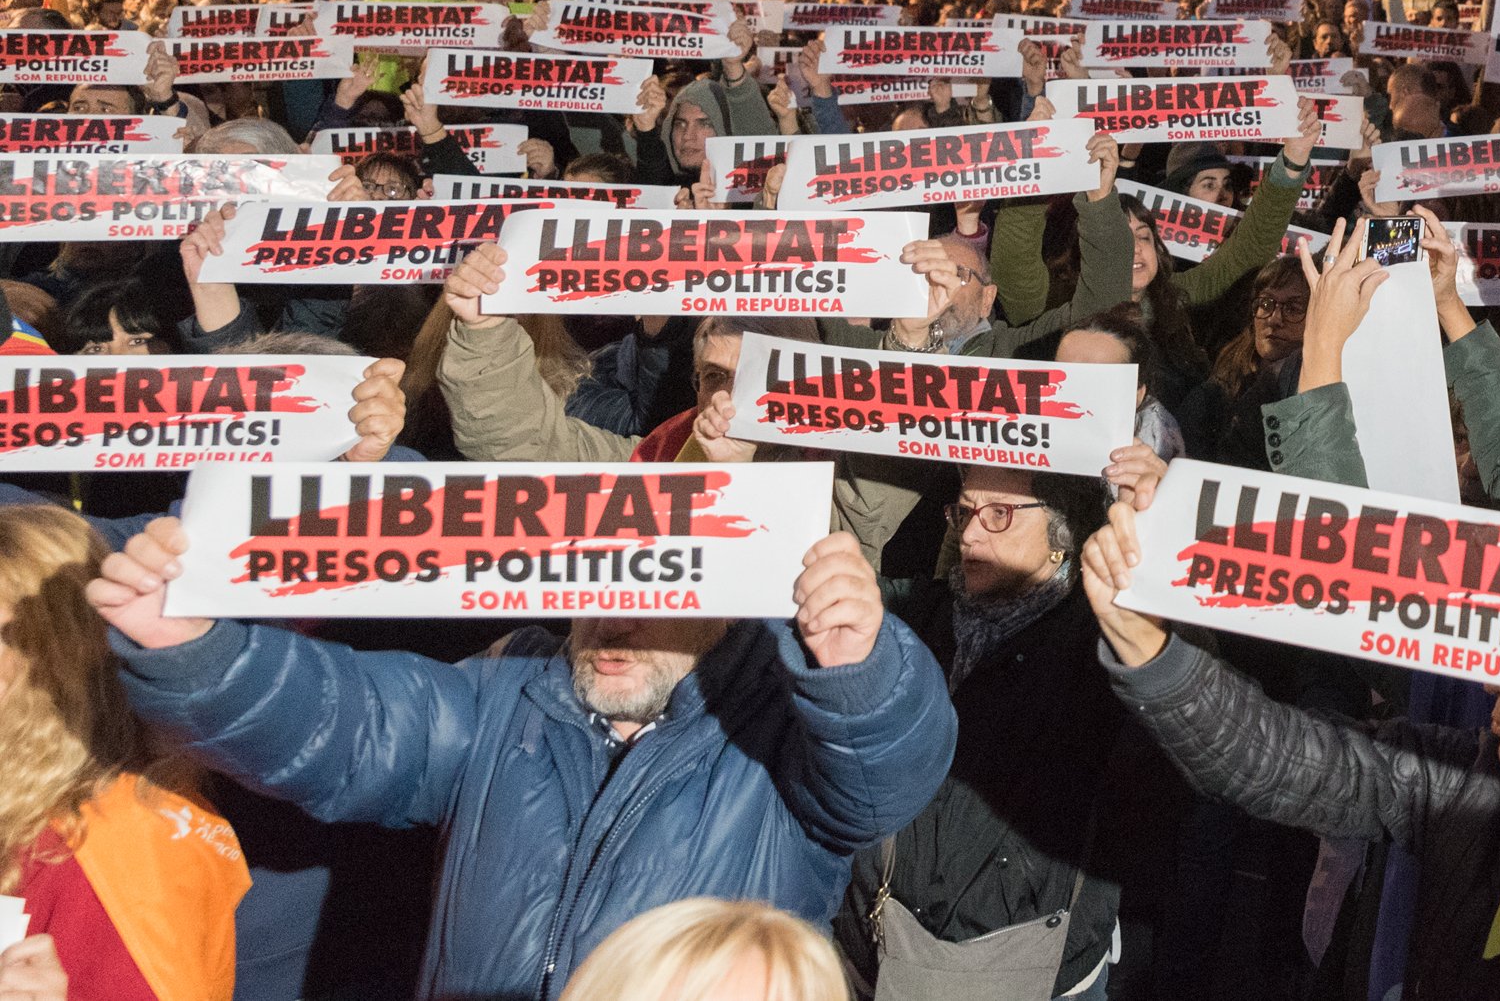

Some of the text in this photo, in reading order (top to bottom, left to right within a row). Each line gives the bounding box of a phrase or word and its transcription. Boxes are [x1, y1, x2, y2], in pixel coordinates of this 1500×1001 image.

[337, 5, 476, 25] LLIBERTAT
[561, 5, 706, 33] LLIBERTAT
[793, 5, 881, 18] LLIBERTAT
[832, 17, 878, 26] POLÍTICS!
[182, 28, 235, 37] PRESOS
[335, 24, 476, 38] PRESOS POLÍTICS!
[558, 28, 704, 48] PRESOS POLÍTICS!
[1102, 25, 1238, 44] LLIBERTAT
[1375, 25, 1470, 43] LLIBERTAT
[173, 39, 315, 61] LIBERTAT
[425, 38, 474, 46] REPÚBLICA
[843, 30, 987, 53] LLIBERTAT
[1101, 43, 1237, 57] PRESOS POLÍTICS!
[1416, 44, 1466, 57] POLÍTICS!
[621, 47, 703, 57] SOM REPÚBLICA
[842, 51, 985, 66] PRESOS POLÍTICS!
[1188, 58, 1236, 66] REPÚBLICA
[15, 56, 109, 72] POLÍTICS!
[231, 57, 316, 74] POLÍTICS!
[447, 53, 610, 83] LLIBERTAT
[933, 66, 984, 75] REPÚBLICA
[46, 72, 108, 82] REPÚBLICA
[230, 71, 314, 81] SOM REPÚBLICA
[445, 78, 606, 100] PRESOS POLÍTICS!
[1078, 81, 1262, 113] LLIBERTAT
[518, 98, 604, 110] SOM REPÚBLICA
[1094, 110, 1262, 131] RESOS POLÍTICS!
[1167, 127, 1262, 140] SOM REPÚBLICA
[814, 128, 1039, 176] LLIBERTAT
[816, 163, 1042, 198] PRESOS POLÍTICS!
[923, 182, 1041, 203] SOM REPÚBLICA
[108, 224, 155, 238] SOM
[538, 218, 849, 264] LLIBERTAT
[253, 246, 374, 267] PRESOS
[380, 268, 425, 281] SOM
[538, 260, 847, 295] PRESOS POLÍTICS!
[681, 293, 845, 313] SOM REPÚBLICA
[0, 366, 288, 414] IBERTAT
[766, 348, 1051, 416] LLIBERTAT
[102, 412, 281, 448] POLÍTICS!
[766, 400, 1052, 450] PRESOS POLÍTICS!
[95, 452, 147, 468] SOM
[897, 438, 1052, 469] SOM REPÚBLICA
[249, 474, 706, 538] LLIBERTAT
[249, 538, 704, 584] PRESOS POLÍTICS!
[1186, 552, 1350, 616] PRESOS
[460, 586, 703, 611] SOM REPÚBLICA
[1359, 629, 1422, 663] SOM
